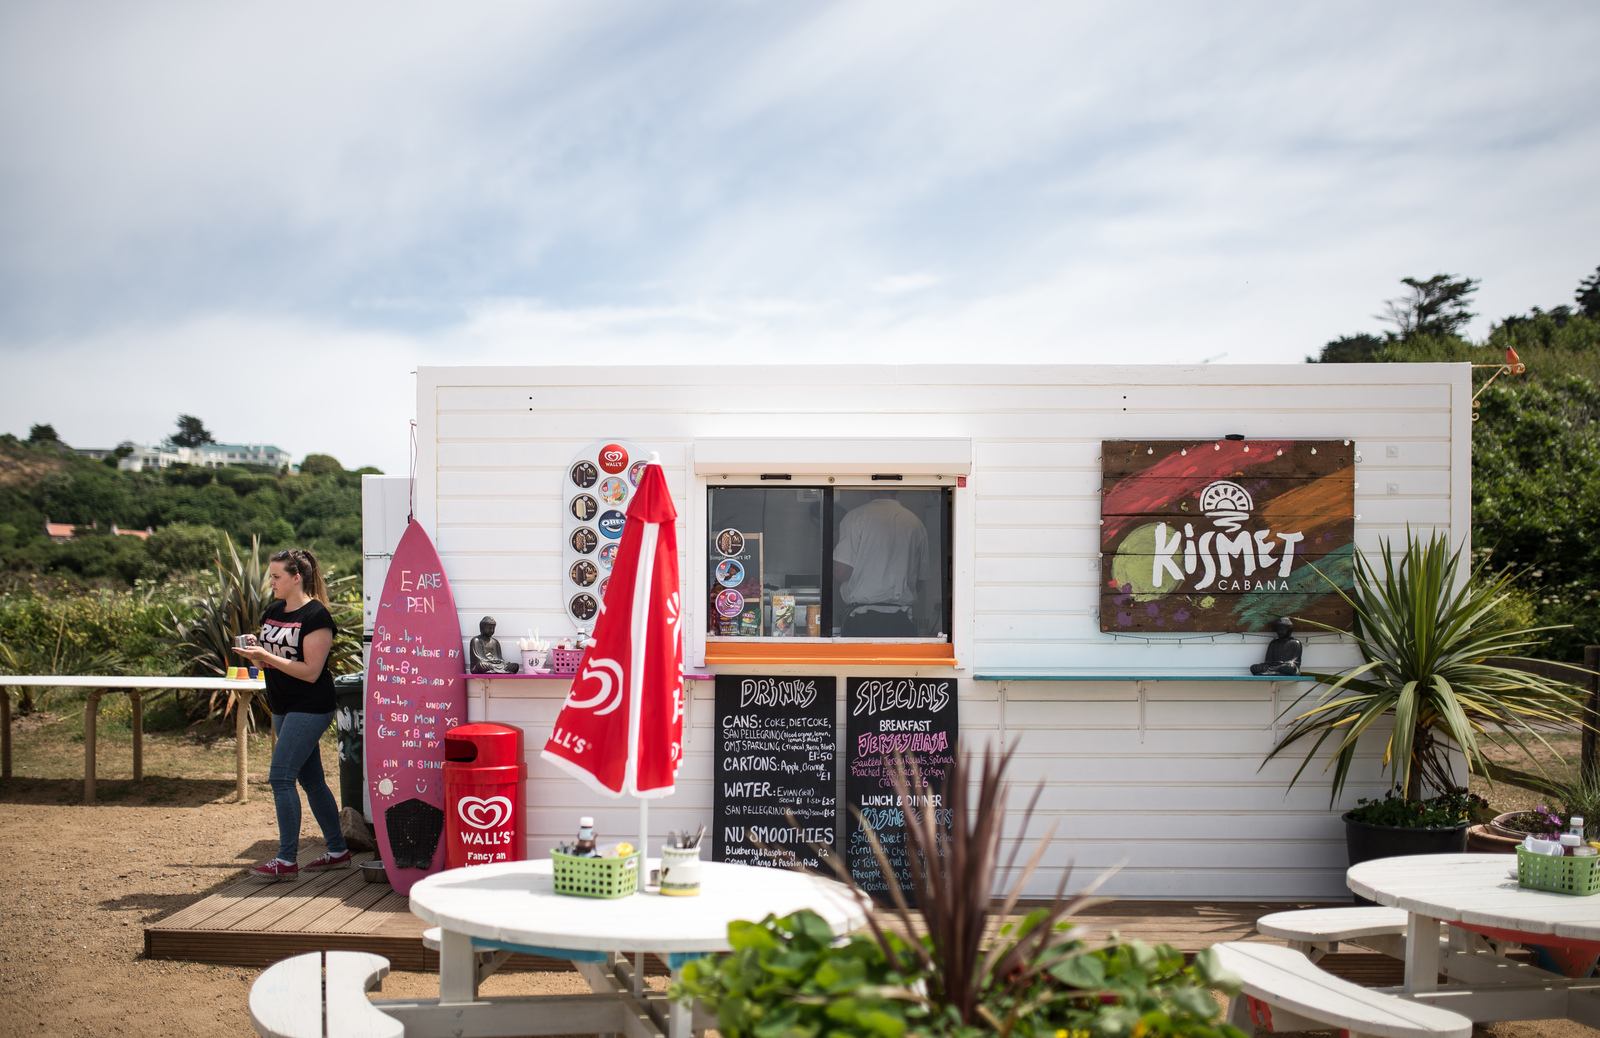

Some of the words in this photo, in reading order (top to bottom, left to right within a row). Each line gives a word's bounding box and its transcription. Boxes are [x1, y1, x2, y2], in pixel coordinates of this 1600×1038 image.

[602, 517, 626, 526] OREO
[416, 573, 442, 590] ARE
[1217, 580, 1290, 591] CABANA
[259, 623, 301, 648] RUN
[374, 641, 409, 655] TUEDA
[376, 657, 419, 675] 9AM-8M
[423, 701, 452, 711] UNDAY
[374, 712, 409, 723] LSED
[414, 713, 459, 727] MONYS
[722, 714, 762, 729] CANS:
[879, 719, 932, 732] BREAKFAST
[413, 728, 436, 740] BNK
[723, 729, 740, 740] SAN
[550, 728, 587, 754] LL'S
[742, 740, 781, 752] SPARKLING
[858, 732, 912, 757] JERSEY
[911, 731, 949, 754] HASH
[380, 759, 398, 769] AIN
[723, 755, 780, 771] CARTONS:
[780, 760, 803, 774] Apple,
[820, 772, 831, 781] £1
[850, 765, 880, 777] Poached
[724, 782, 776, 797] WATER:
[861, 794, 893, 807] LUNCH
[896, 795, 904, 806] &
[725, 805, 740, 816] SAN
[742, 805, 786, 816] PELLEGRINO
[460, 831, 512, 845] WALL'S
[725, 826, 745, 843] NU
[749, 825, 834, 845] SMOOTHIES
[880, 833, 901, 844] Sweet
[467, 851, 494, 864] Fancy
[495, 852, 507, 860] an
[818, 848, 829, 858] £2
